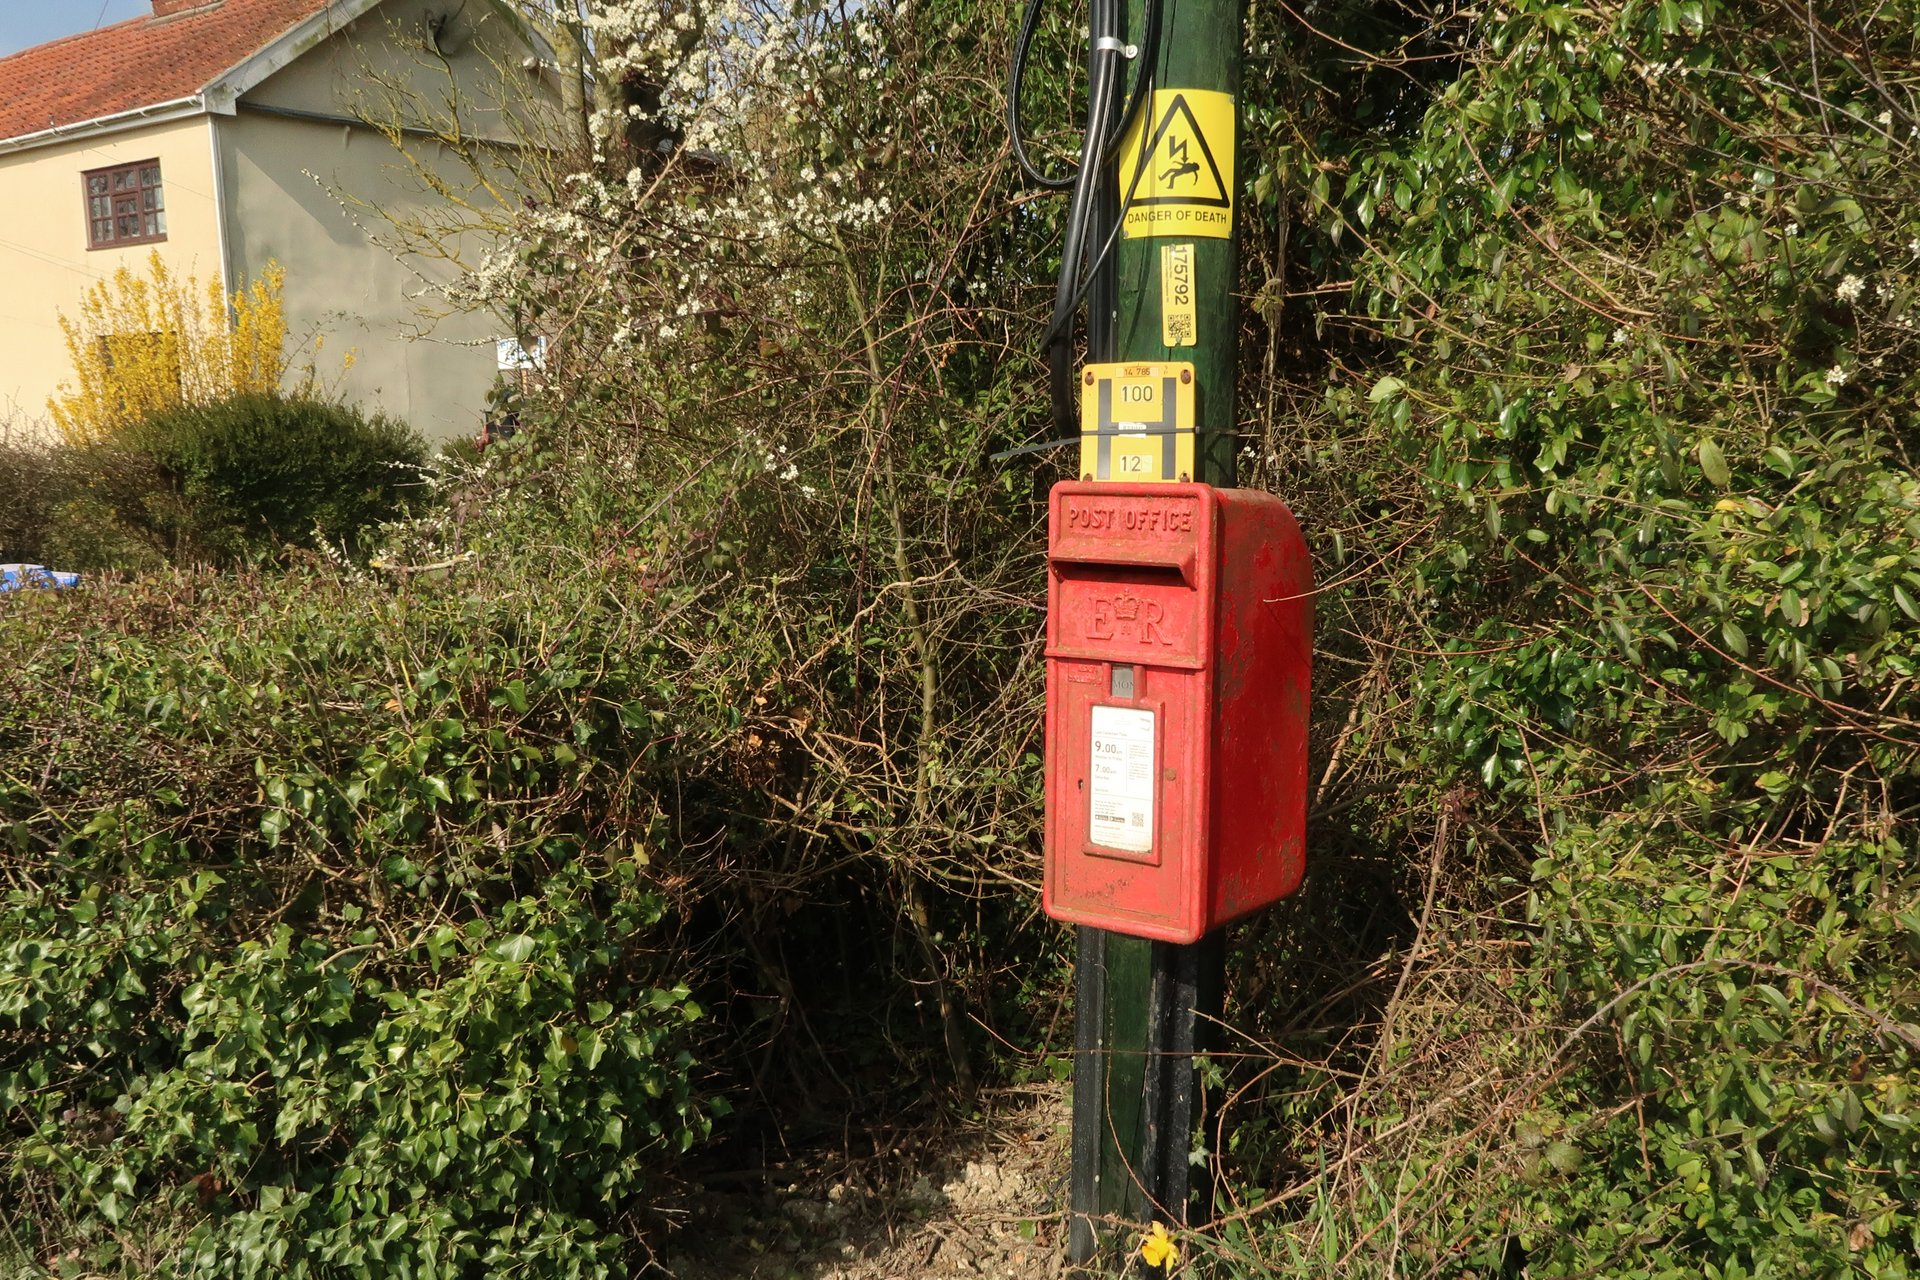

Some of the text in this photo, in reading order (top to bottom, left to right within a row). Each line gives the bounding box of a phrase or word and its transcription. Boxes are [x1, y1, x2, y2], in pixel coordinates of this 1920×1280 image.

[1128, 210, 1227, 224] DANGER OF DEATH
[1174, 246, 1189, 306] 175792
[1122, 385, 1153, 402] 100
[1121, 455, 1141, 472] 12
[1069, 507, 1192, 532] POST OFFICE
